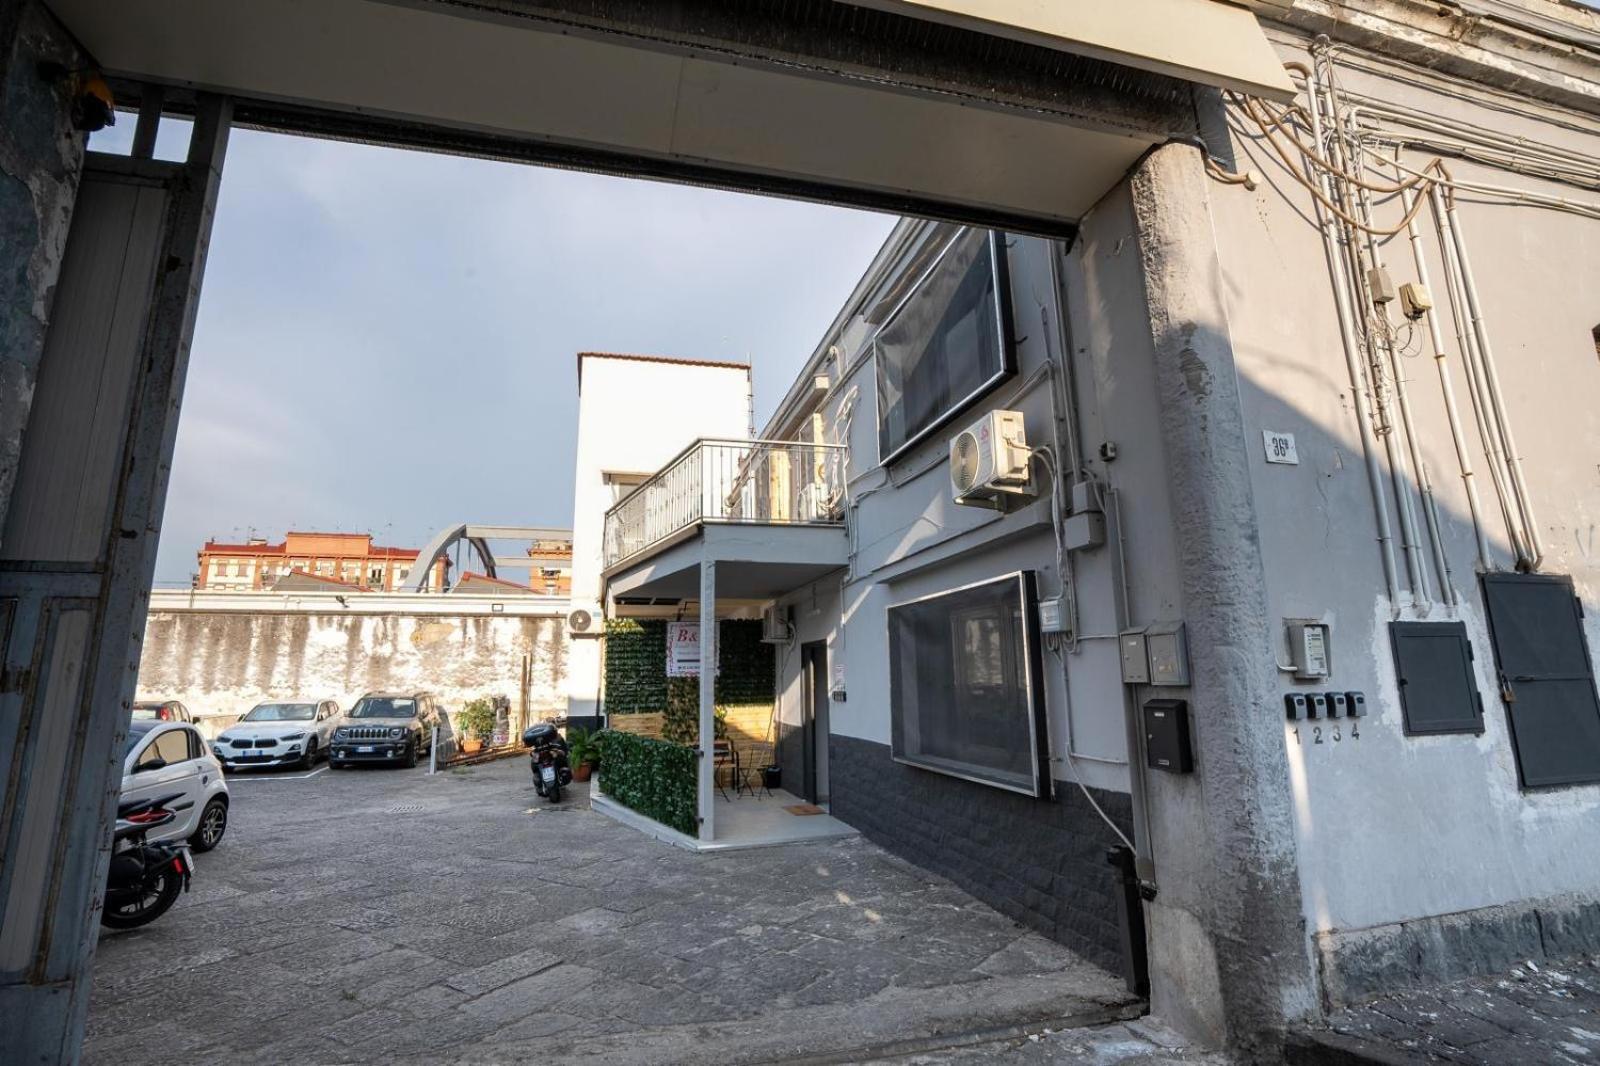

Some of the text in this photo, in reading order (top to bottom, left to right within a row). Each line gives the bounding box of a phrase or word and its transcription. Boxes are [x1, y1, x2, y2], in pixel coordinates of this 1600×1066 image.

[677, 629, 698, 642] B&
[1293, 723, 1360, 744] 1 2 3 4
